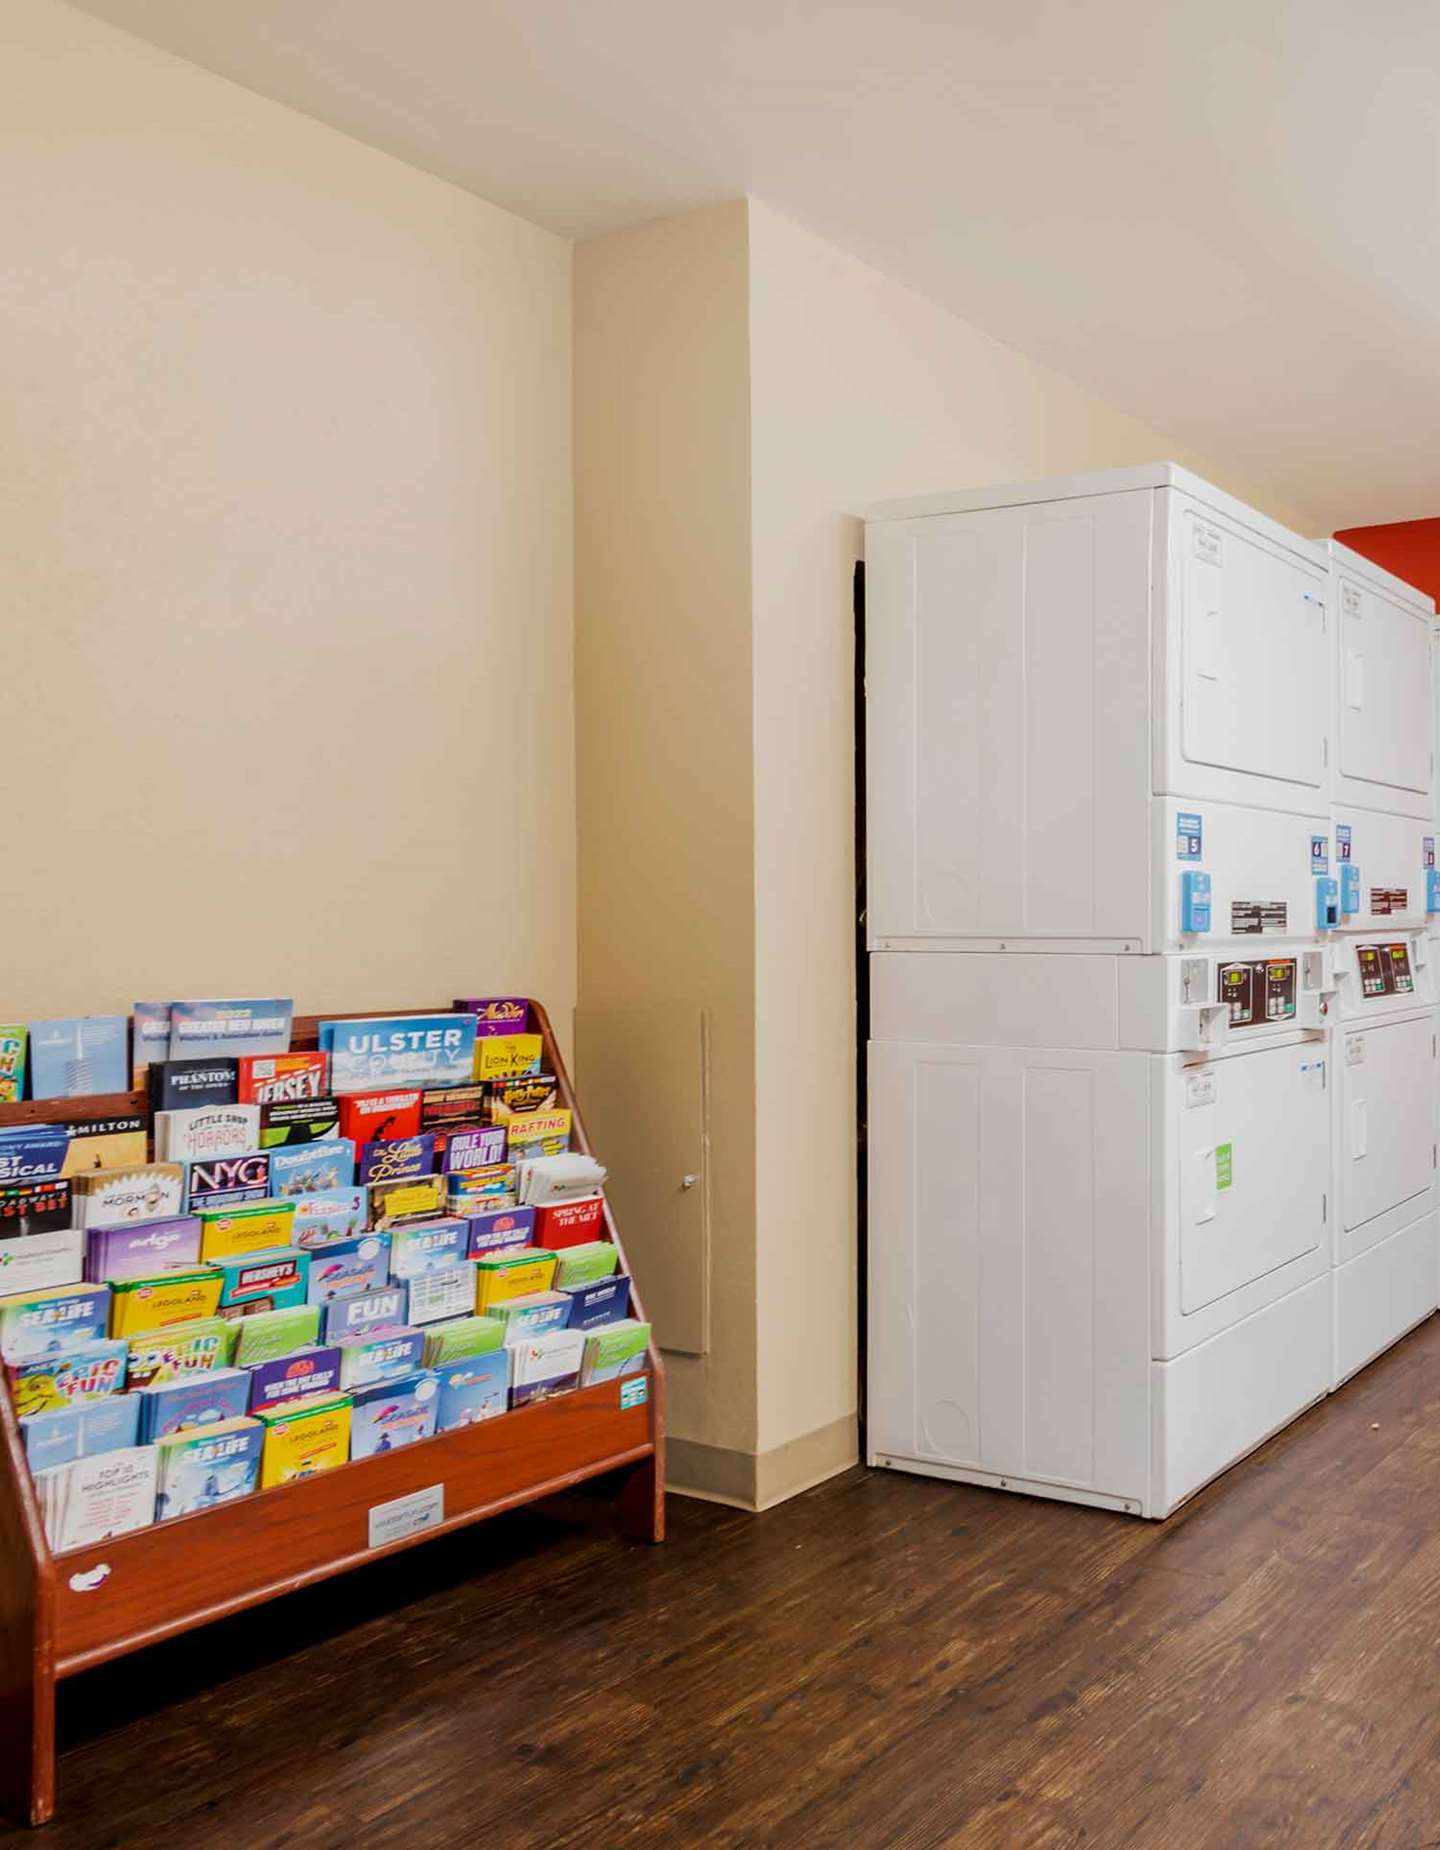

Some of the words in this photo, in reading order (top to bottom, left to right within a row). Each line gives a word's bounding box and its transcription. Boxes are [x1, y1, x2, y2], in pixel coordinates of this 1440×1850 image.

[1190, 840, 1198, 852] 5
[350, 1027, 462, 1055] ULSTER
[256, 1069, 322, 1102] JERSEY
[510, 1117, 566, 1136] RAFTING
[0, 1163, 58, 1178] SICAL
[191, 1156, 269, 1194] NYC
[346, 1294, 400, 1326] FUN
[172, 1353, 215, 1371] FUN
[65, 1375, 117, 1397] FUN
